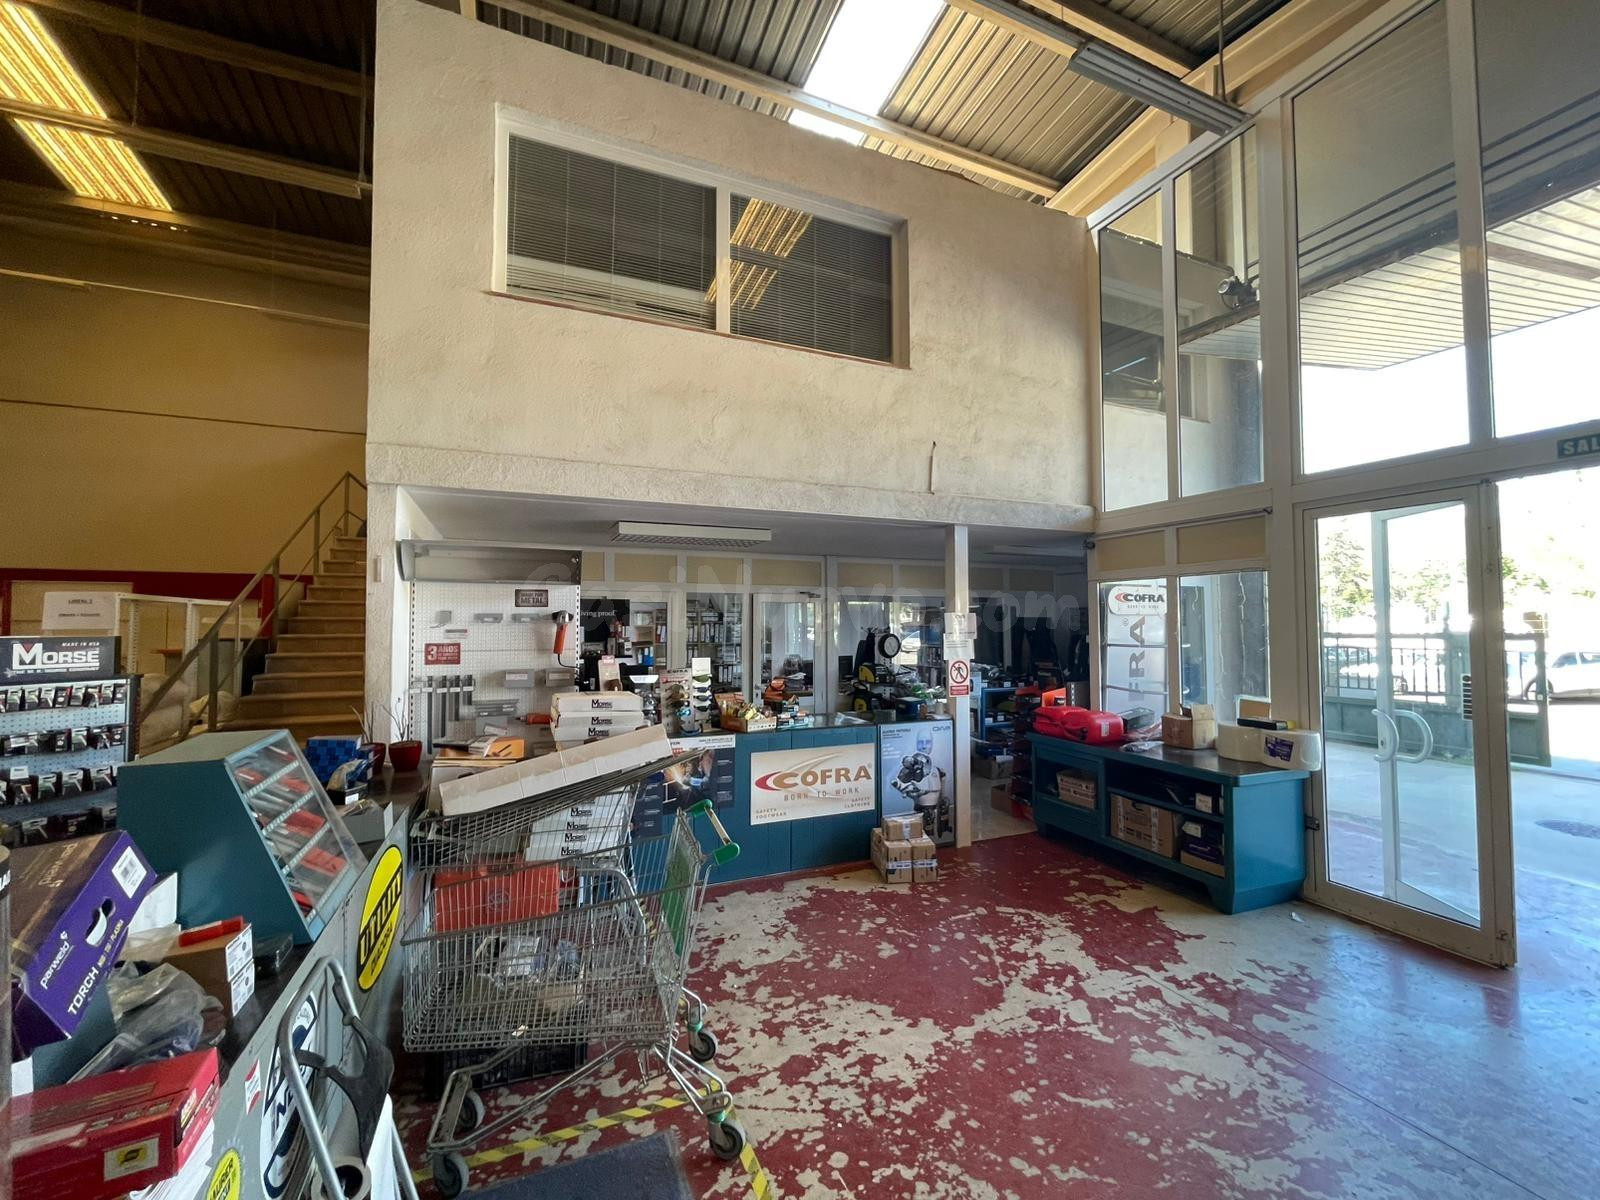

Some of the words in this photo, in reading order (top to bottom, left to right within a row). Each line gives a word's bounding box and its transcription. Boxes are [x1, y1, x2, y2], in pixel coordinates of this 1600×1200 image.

[1563, 437, 1600, 455] SAL
[1122, 593, 1165, 602] COFRA
[12, 643, 100, 670] MORSE
[428, 645, 437, 660] 3
[1129, 615, 1145, 702] FRA
[773, 765, 872, 788] COFRA
[784, 793, 808, 801] BORN
[835, 787, 860, 795] WORK
[40, 940, 70, 989] parweld
[68, 966, 99, 1015] TORCH
